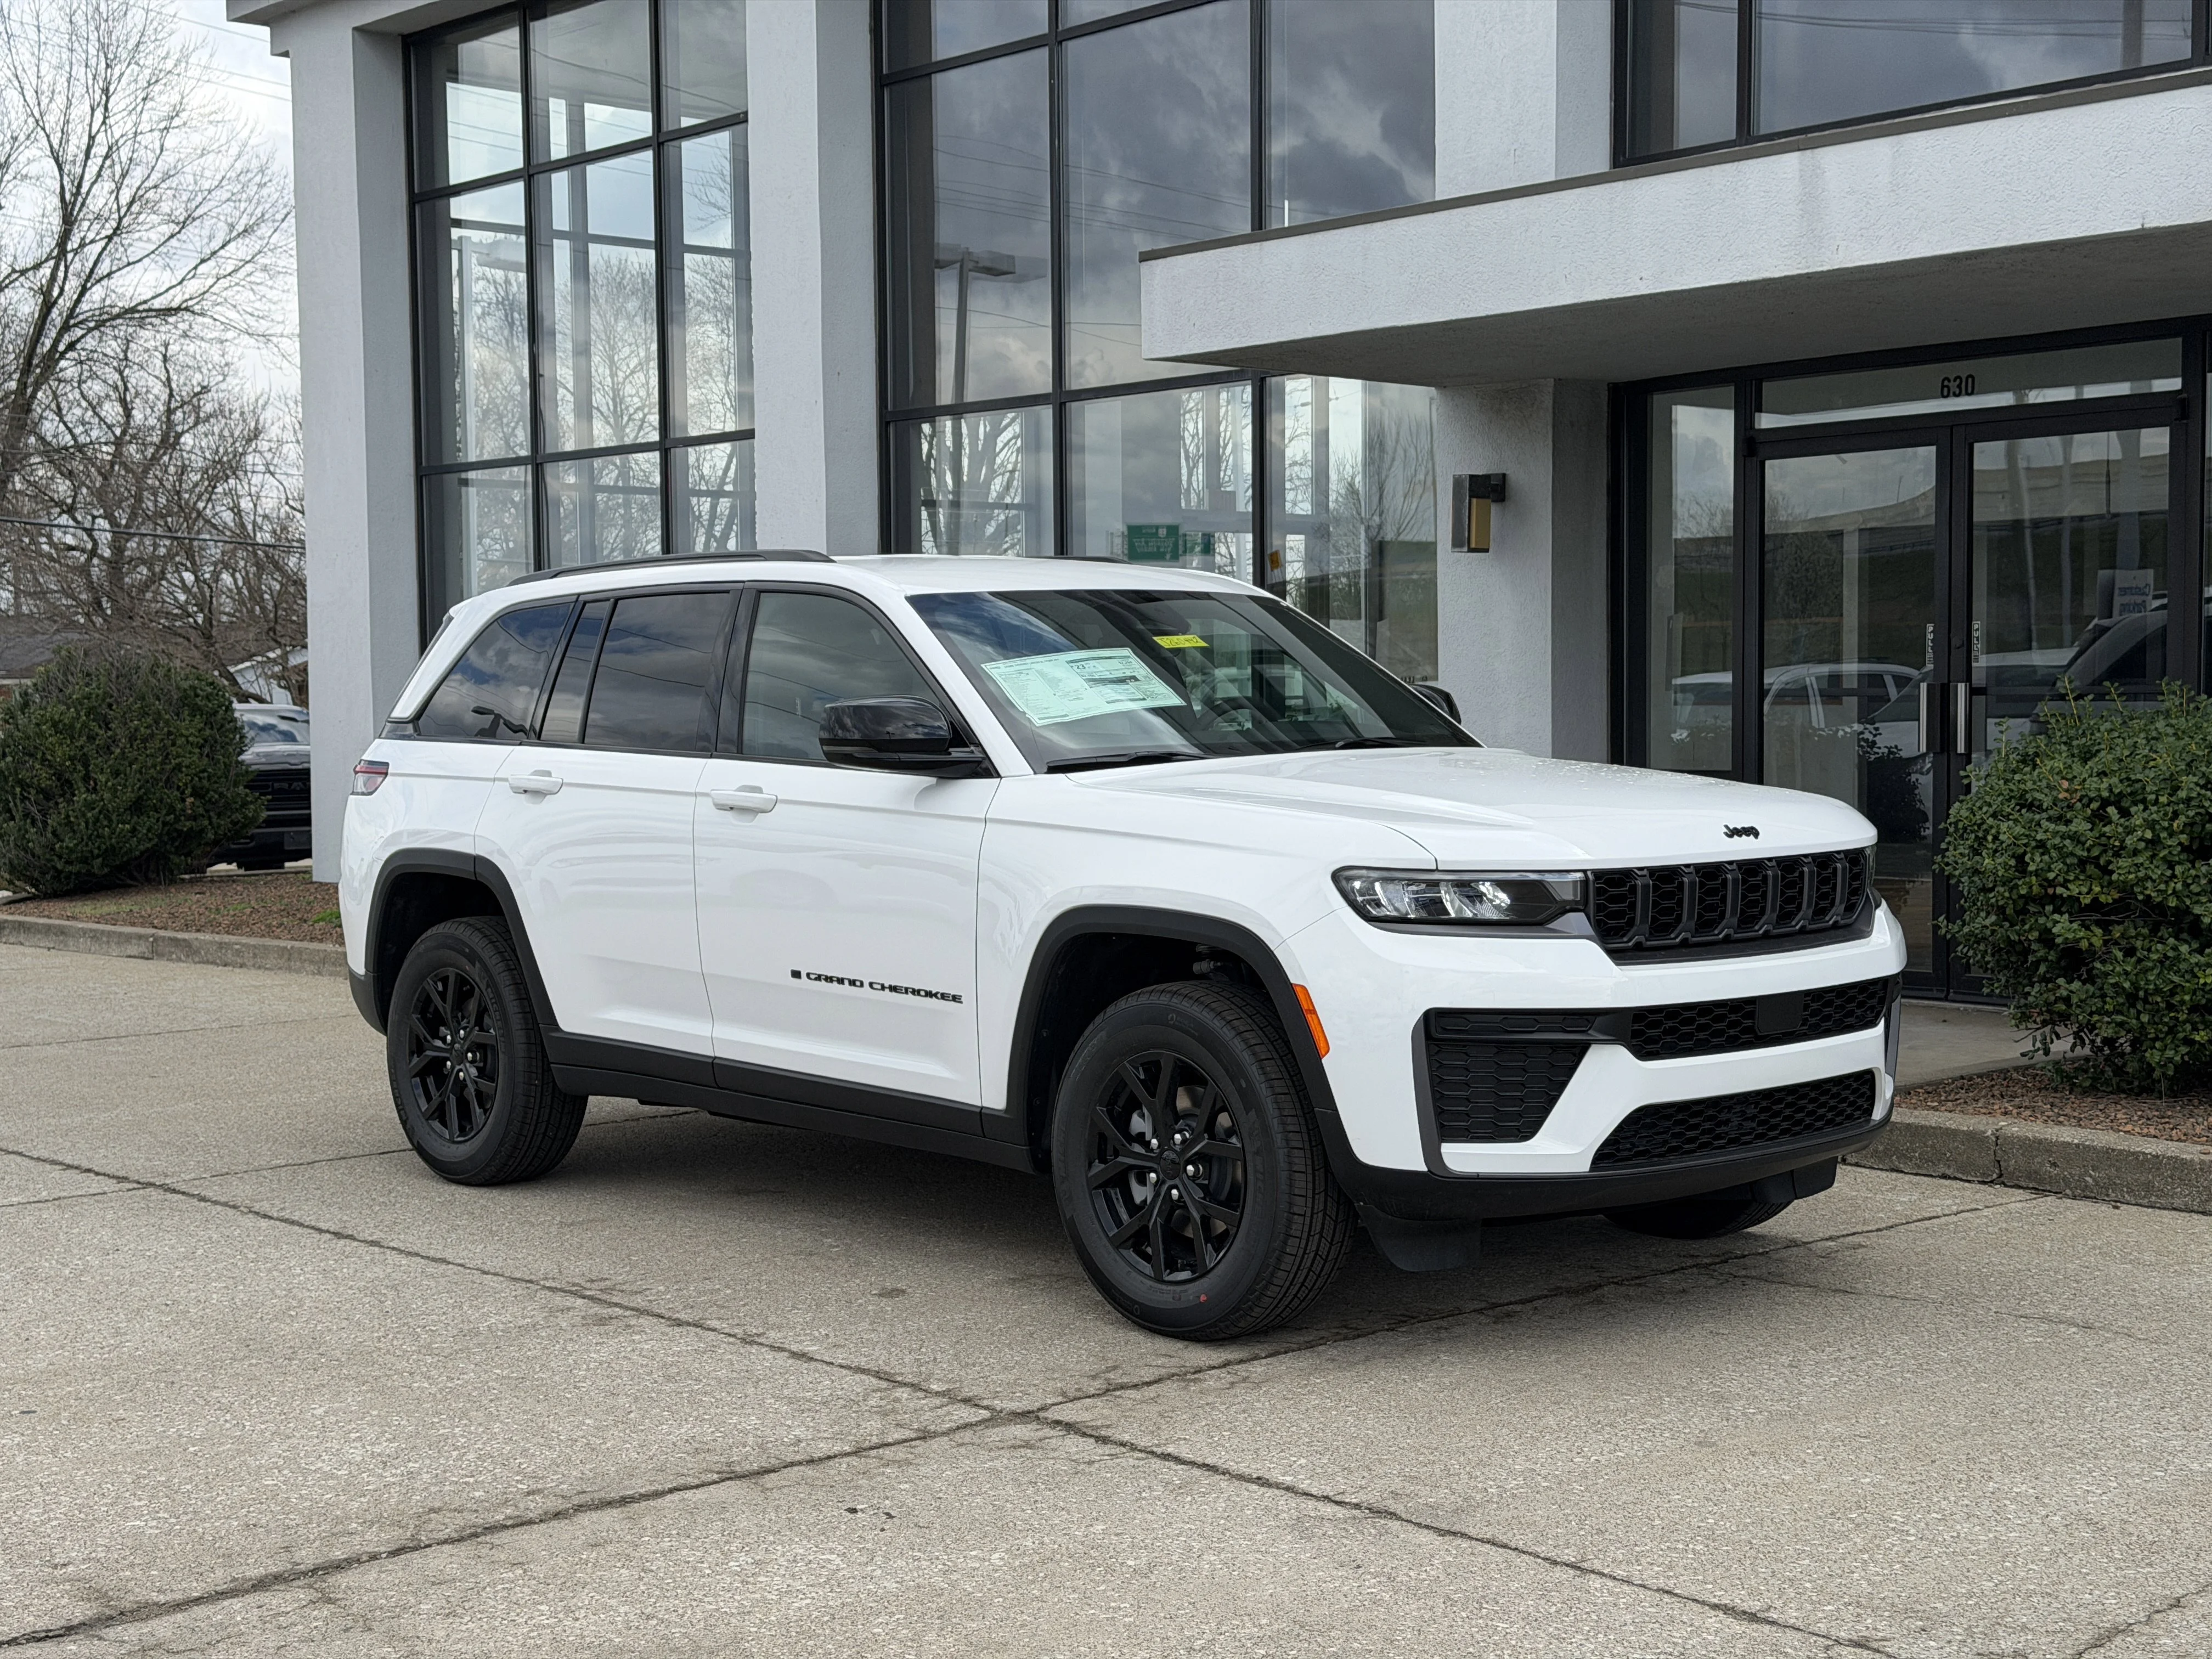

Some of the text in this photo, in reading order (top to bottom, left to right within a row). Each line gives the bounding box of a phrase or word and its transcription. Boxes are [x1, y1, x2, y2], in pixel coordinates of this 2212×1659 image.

[1940, 374, 1976, 398] 630
[273, 781, 311, 791] RA
[1723, 824, 1760, 840] Jeep
[805, 971, 964, 1005] GRAND CHEROKEE
